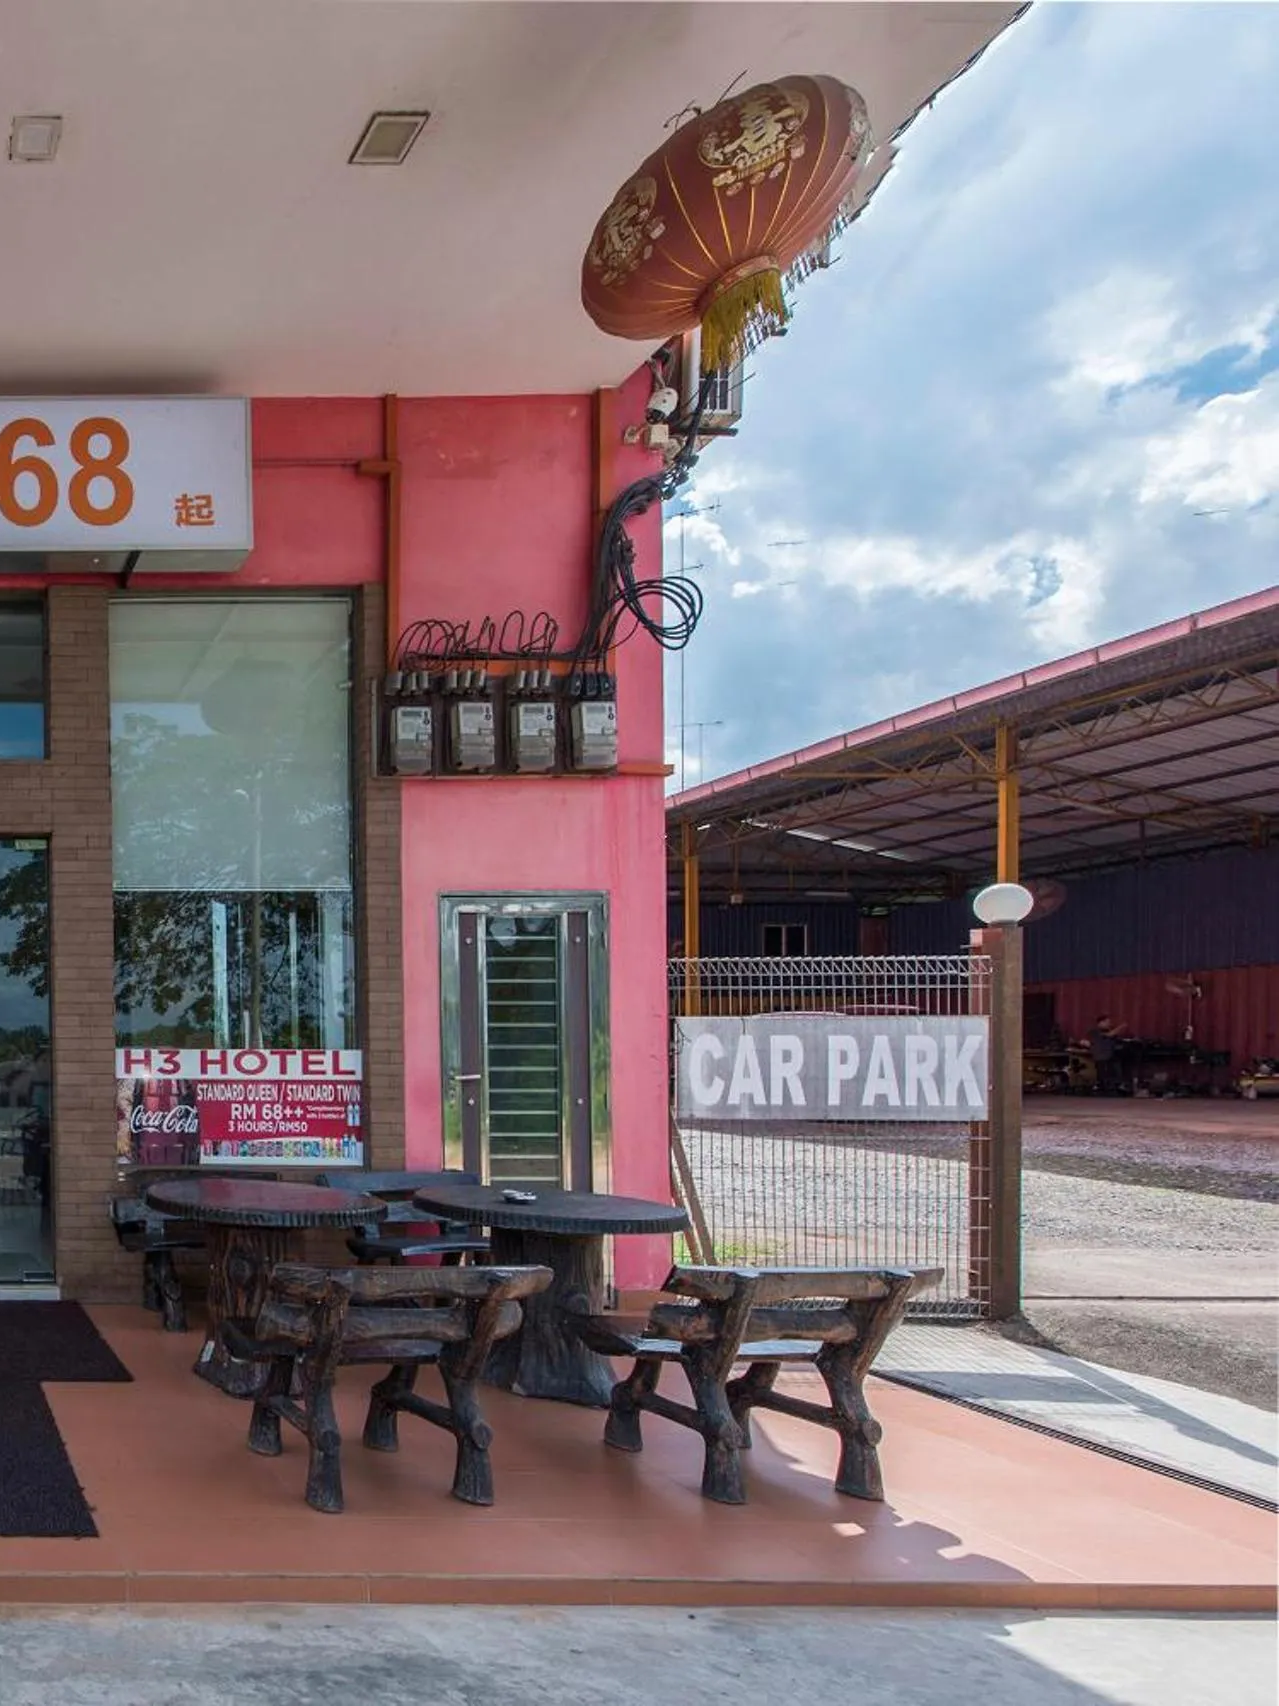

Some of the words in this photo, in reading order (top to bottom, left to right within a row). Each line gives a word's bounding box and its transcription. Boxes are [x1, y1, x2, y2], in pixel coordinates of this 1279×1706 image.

[173, 493, 216, 527] 起
[123, 1050, 181, 1075] H3
[200, 1050, 356, 1075] HOTEL
[688, 1032, 807, 1106] CAR
[827, 1034, 984, 1107] PARK
[196, 1084, 245, 1101] STANDARD
[246, 1084, 279, 1101] QUEEN
[286, 1084, 335, 1101] STANDARD
[231, 1105, 257, 1120] RM
[228, 1121, 235, 1132] 3
